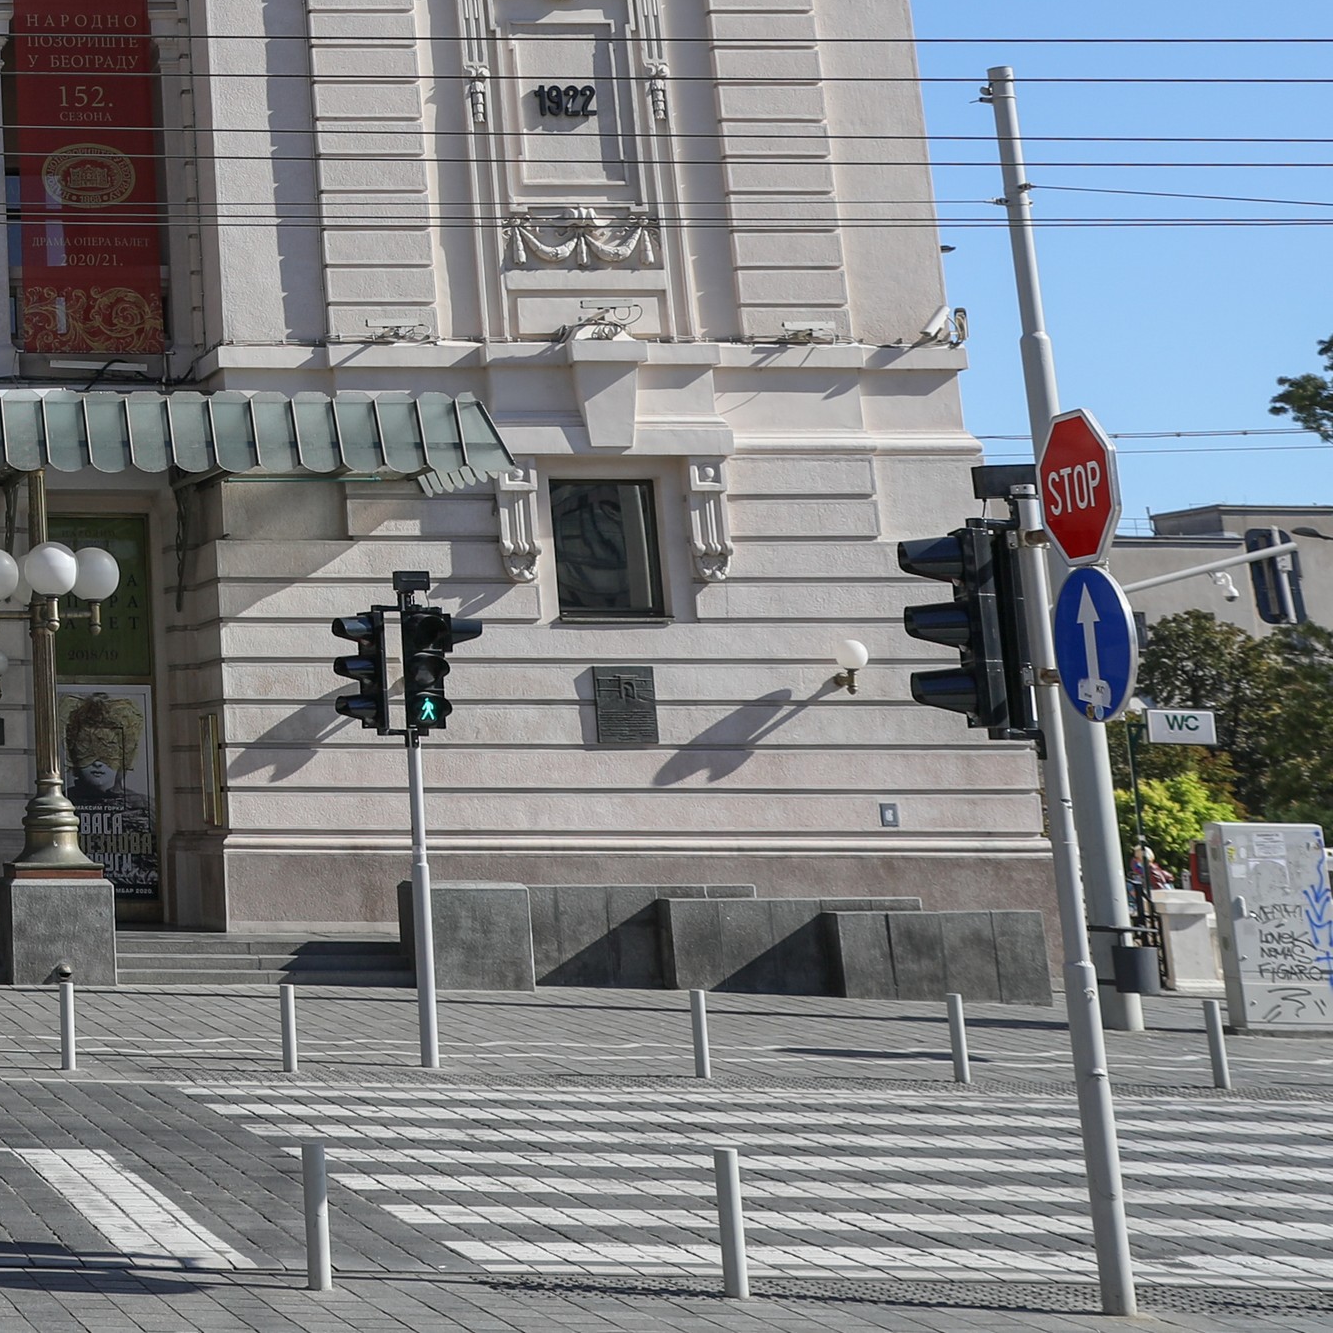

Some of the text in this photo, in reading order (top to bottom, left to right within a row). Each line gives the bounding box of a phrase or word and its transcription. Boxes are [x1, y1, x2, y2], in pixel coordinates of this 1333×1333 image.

[26, 14, 137, 29] НАРОДНО
[28, 55, 139, 70] У БЕОГРАДУ
[59, 86, 113, 107] 152.
[534, 85, 598, 117] 1922
[59, 112, 113, 121] СЕЗОНА
[32, 237, 150, 247] ДРАМА ОПЕРА БАЛЕТ
[1048, 460, 1101, 516] STOP
[1164, 714, 1200, 732] WC
